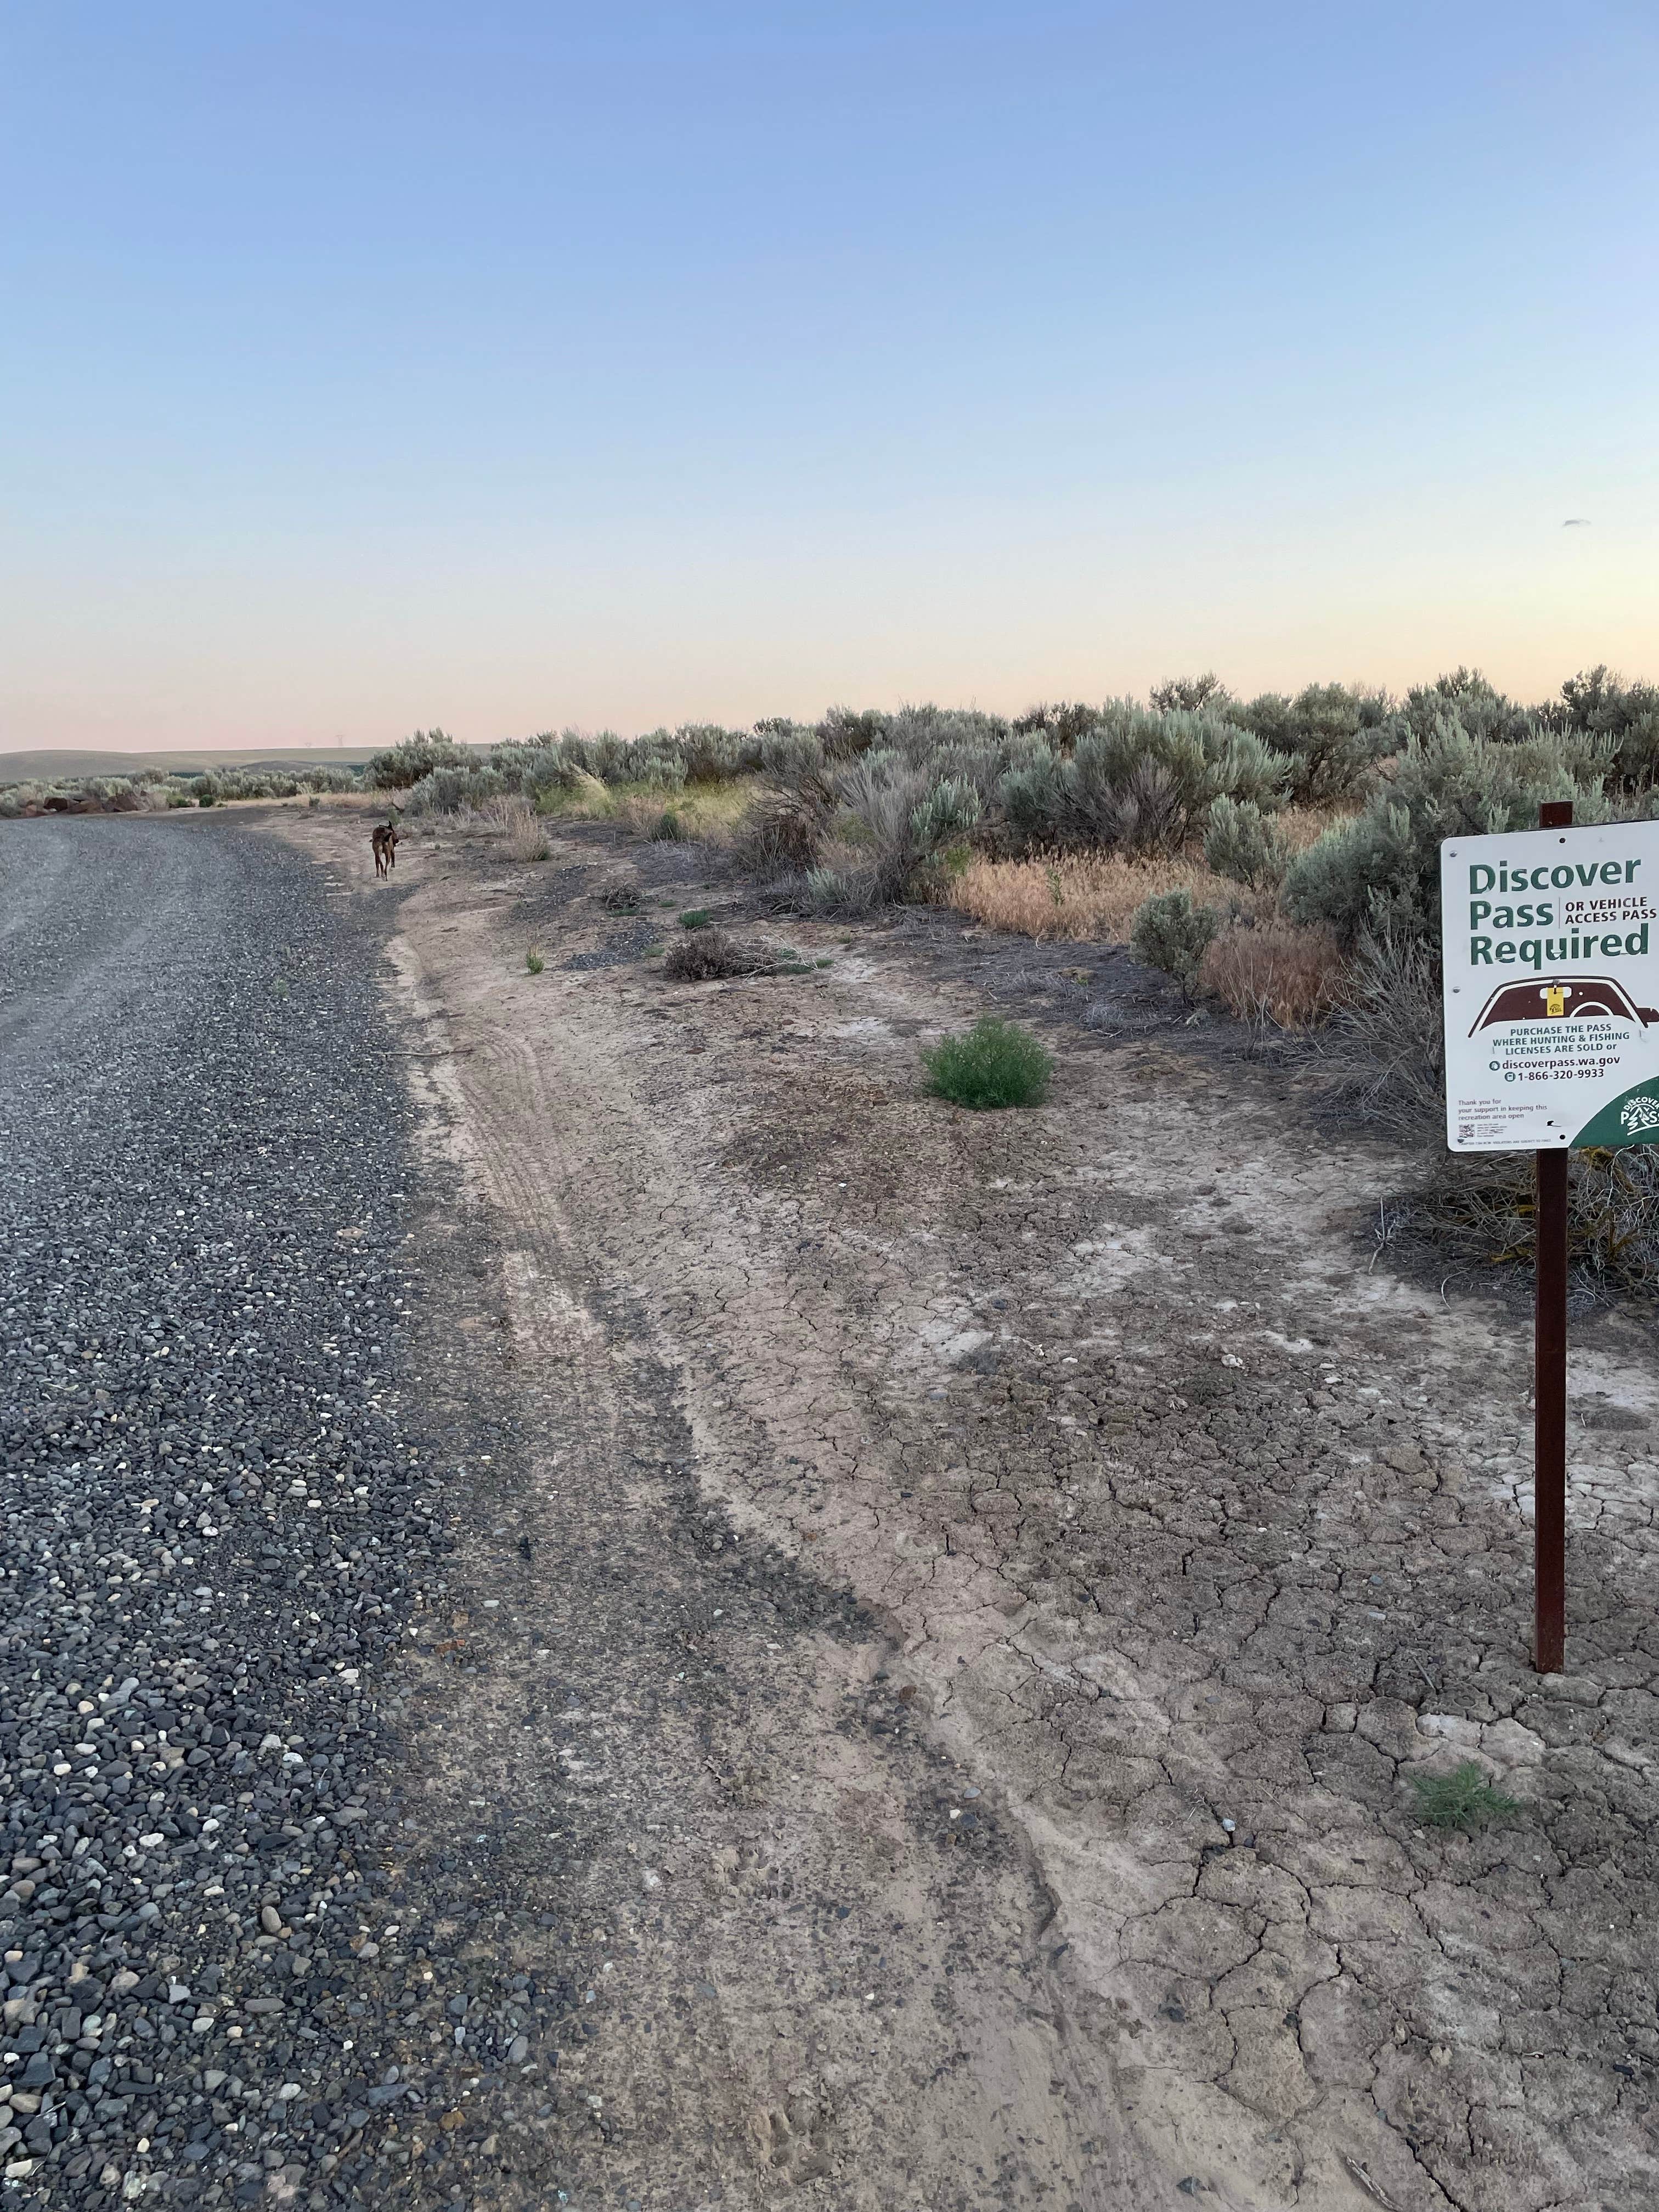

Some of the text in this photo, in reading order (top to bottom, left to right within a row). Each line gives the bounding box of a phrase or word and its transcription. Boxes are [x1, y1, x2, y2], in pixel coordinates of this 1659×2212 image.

[1470, 859, 1641, 894] Discover
[1565, 896, 1647, 912] OR VEHICLE
[1470, 900, 1554, 930] Pass
[1565, 909, 1657, 924] ACCESS PASS
[1471, 923, 1649, 970] Required
[1510, 1024, 1611, 1036] PURCHASE THE PASS
[1493, 1037, 1528, 1046] WHERE
[1531, 1035, 1576, 1045] HUNTING
[1589, 1032, 1630, 1041] FISHING
[1505, 1046, 1551, 1055] LICENSES
[1554, 1045, 1573, 1053] ARE
[1577, 1043, 1602, 1052] SOLD
[1502, 1056, 1620, 1069] discoverpass.wa.gov
[1518, 1069, 1604, 1081] 1-866-320-9933
